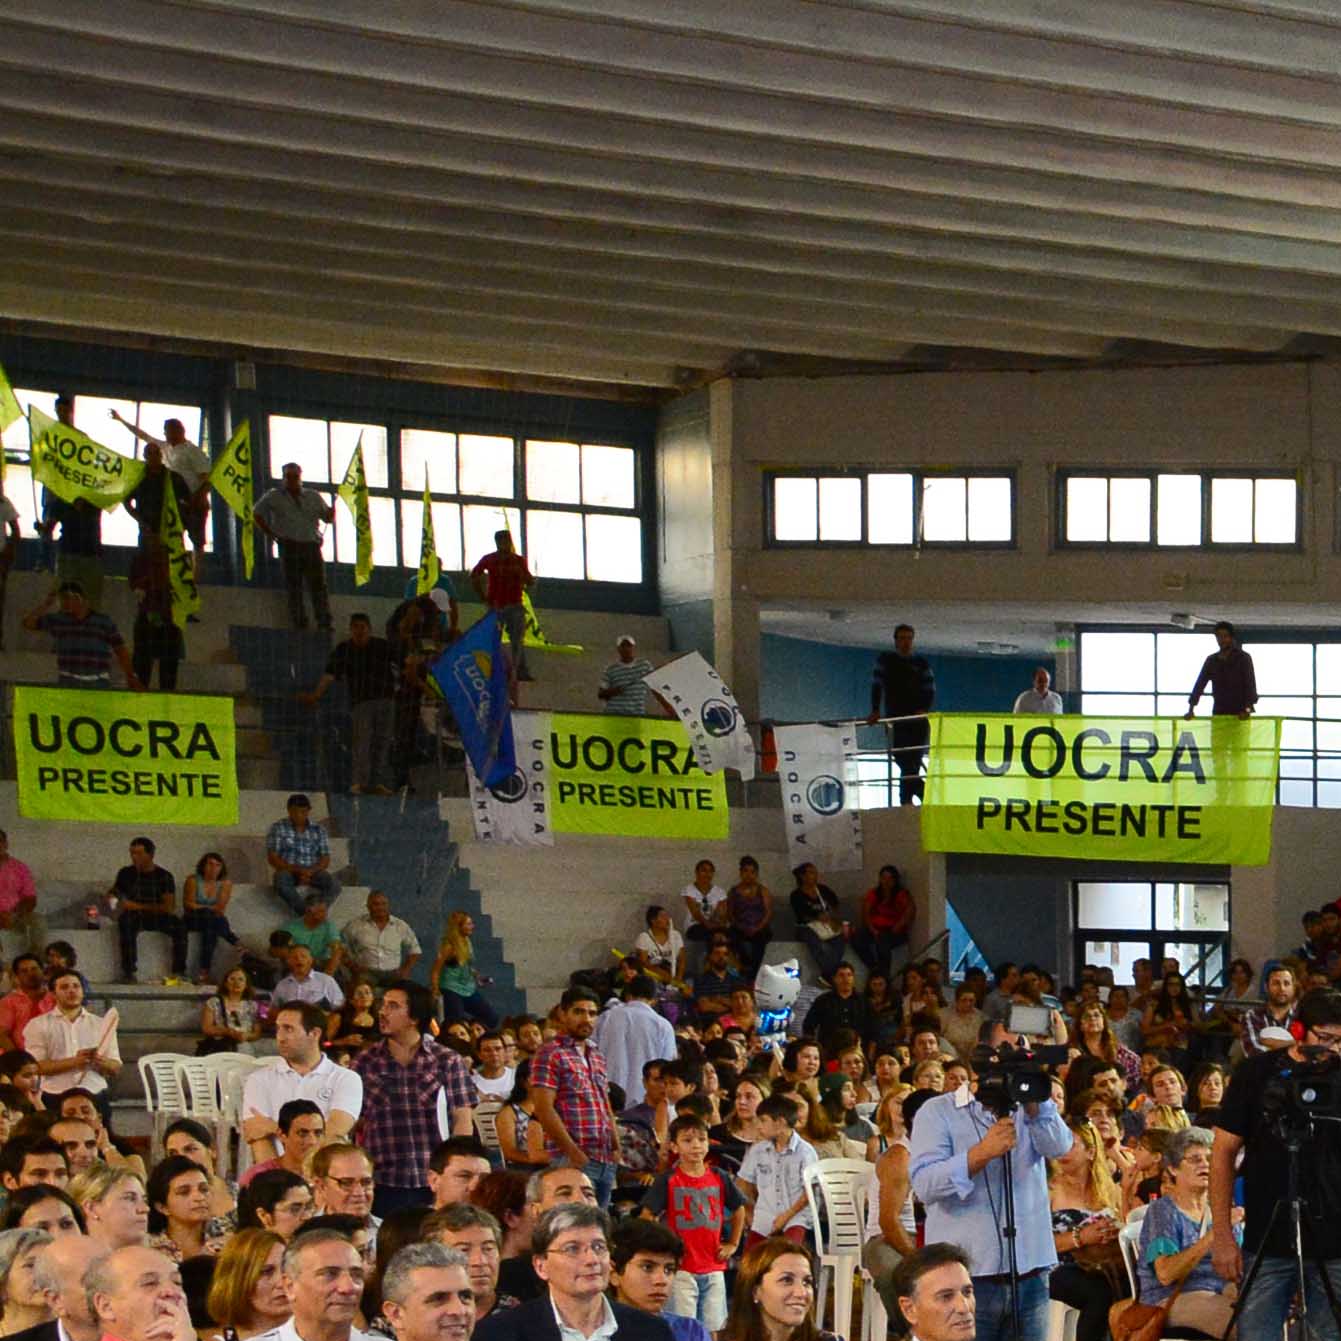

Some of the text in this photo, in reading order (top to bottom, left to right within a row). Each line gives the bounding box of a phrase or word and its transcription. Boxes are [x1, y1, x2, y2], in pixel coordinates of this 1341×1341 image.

[45, 431, 123, 477] UOCRA
[29, 713, 221, 760] UOCRA
[975, 723, 1206, 785] UOCRA
[38, 767, 222, 798] PRESENTE
[530, 738, 545, 835] UOCRA
[558, 781, 713, 811] PRESENTE
[976, 797, 1203, 839] PRESENTE
